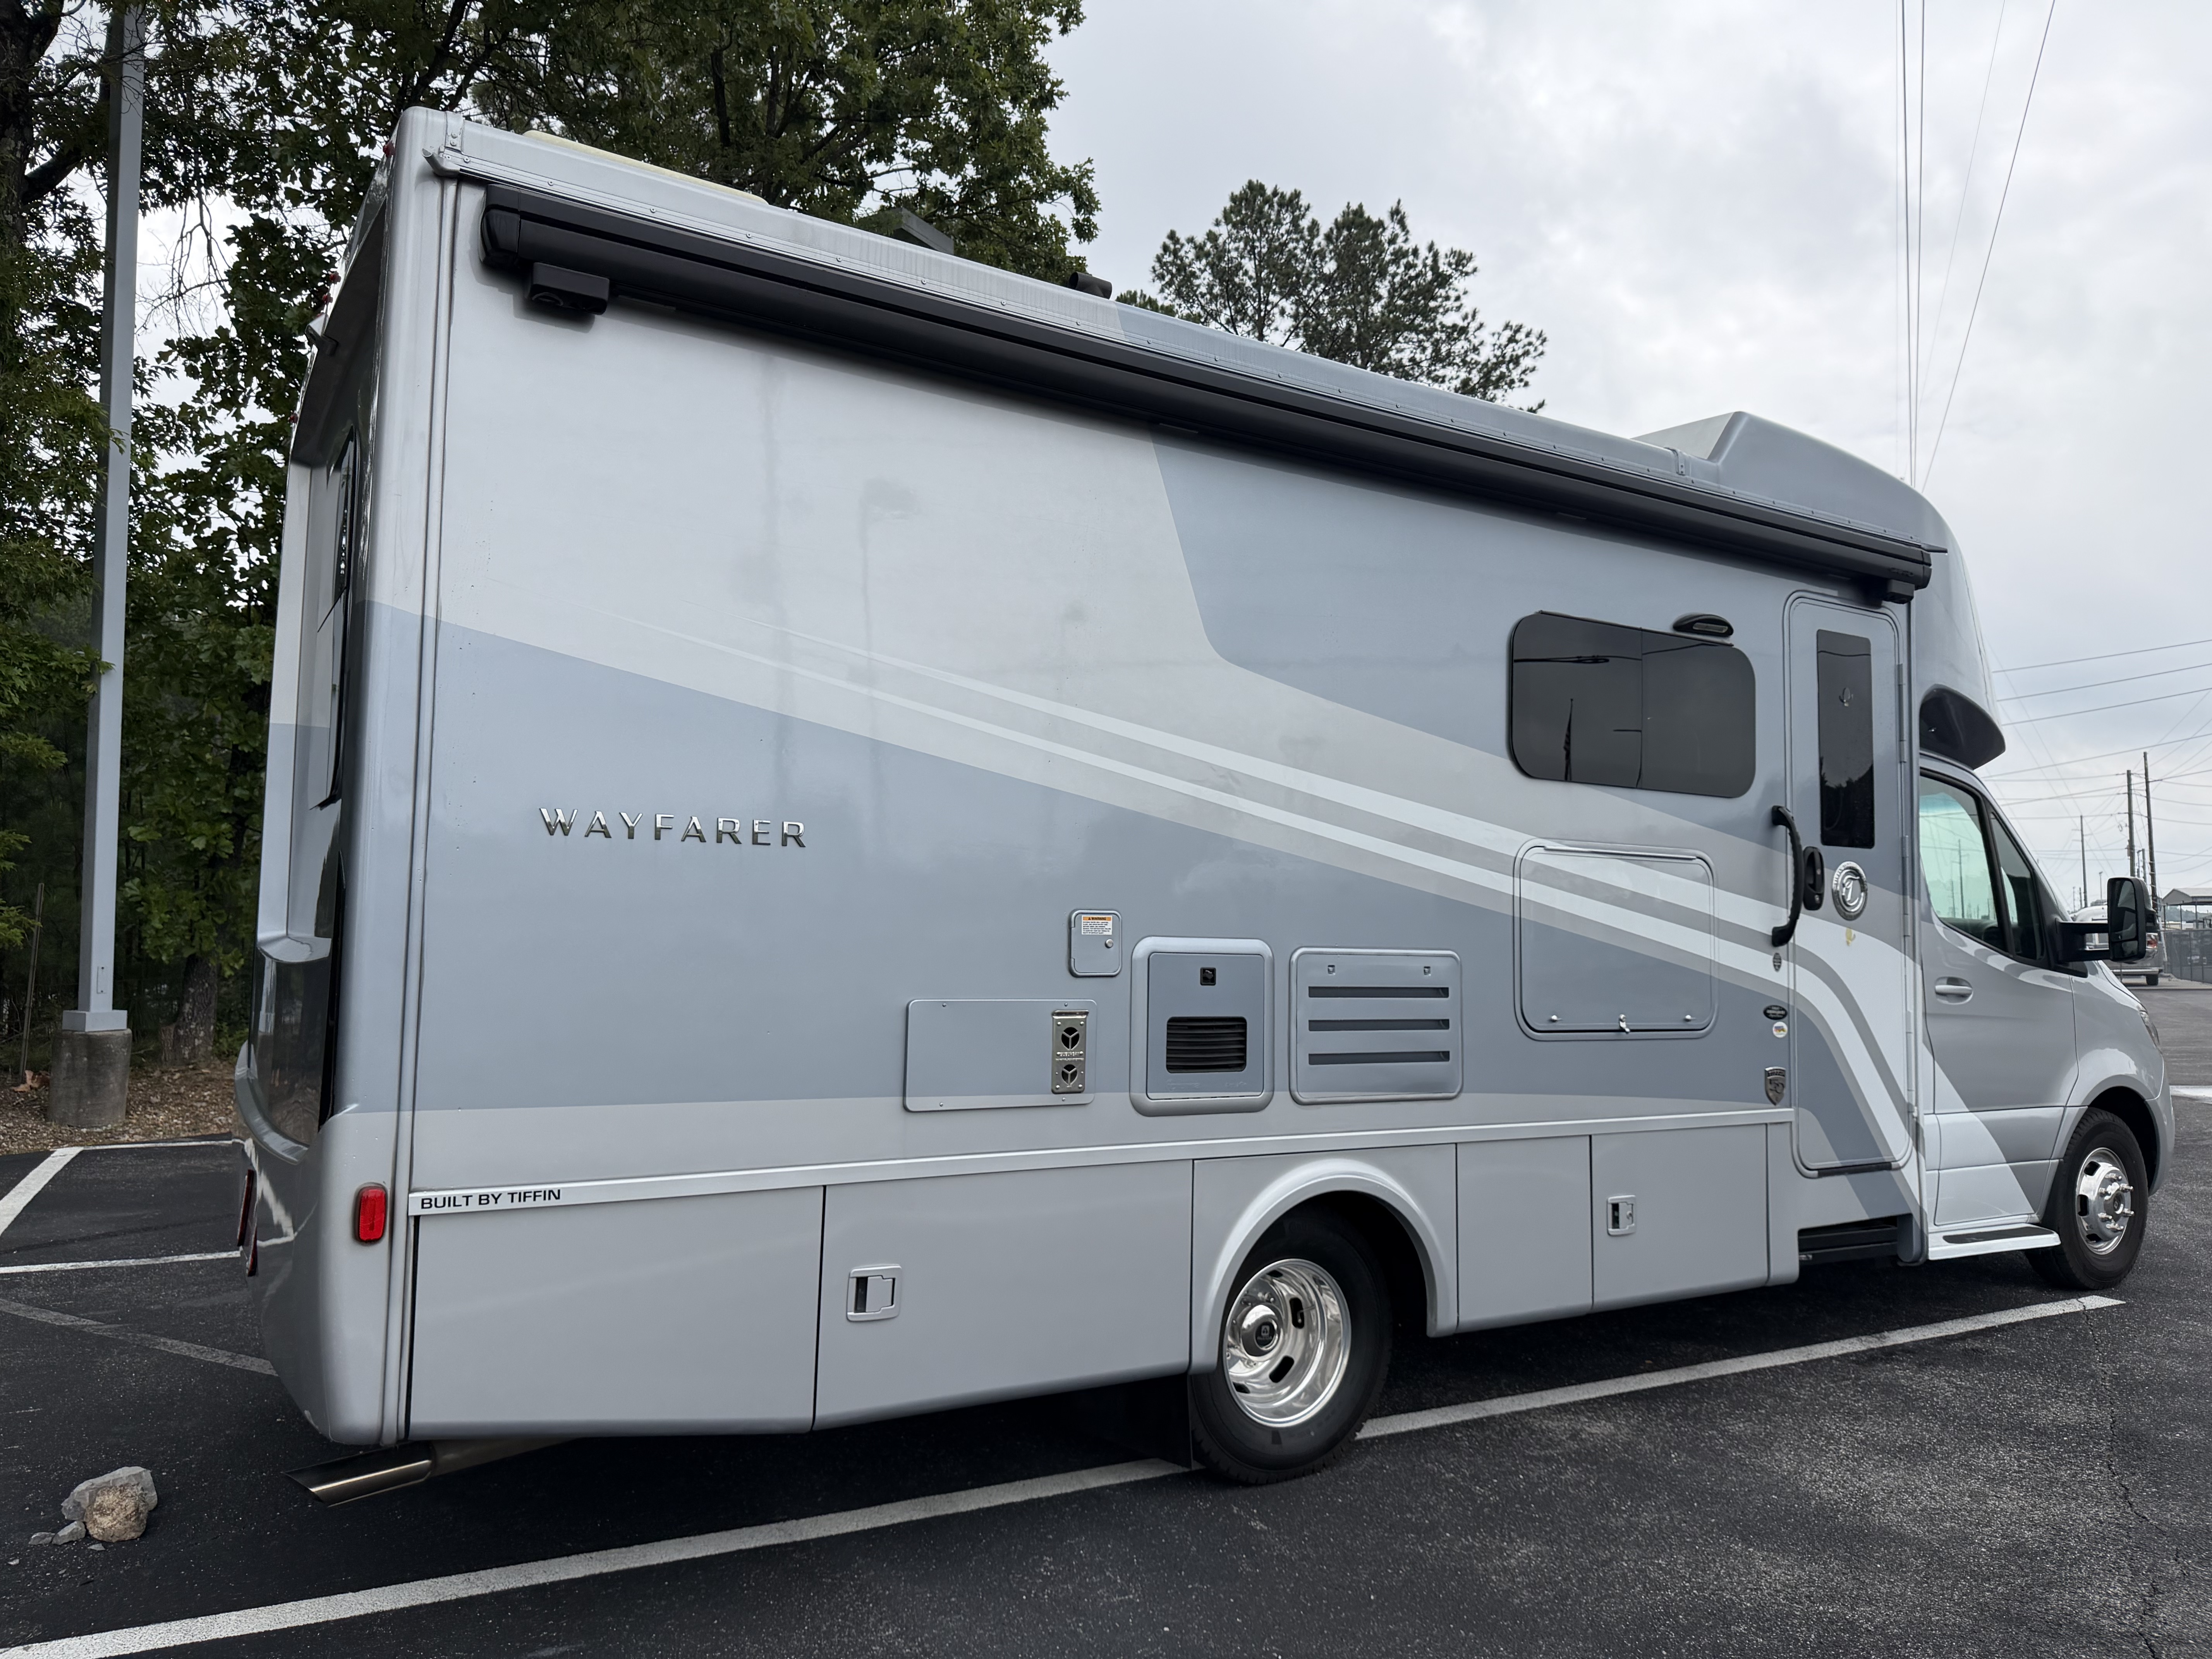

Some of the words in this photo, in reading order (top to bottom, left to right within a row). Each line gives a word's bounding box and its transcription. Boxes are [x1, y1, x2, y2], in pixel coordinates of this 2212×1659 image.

[539, 807, 806, 847] WAYFARER
[421, 1195, 473, 1209] BUILT
[478, 1193, 502, 1205] BY
[507, 1189, 561, 1203] TIFFIN
